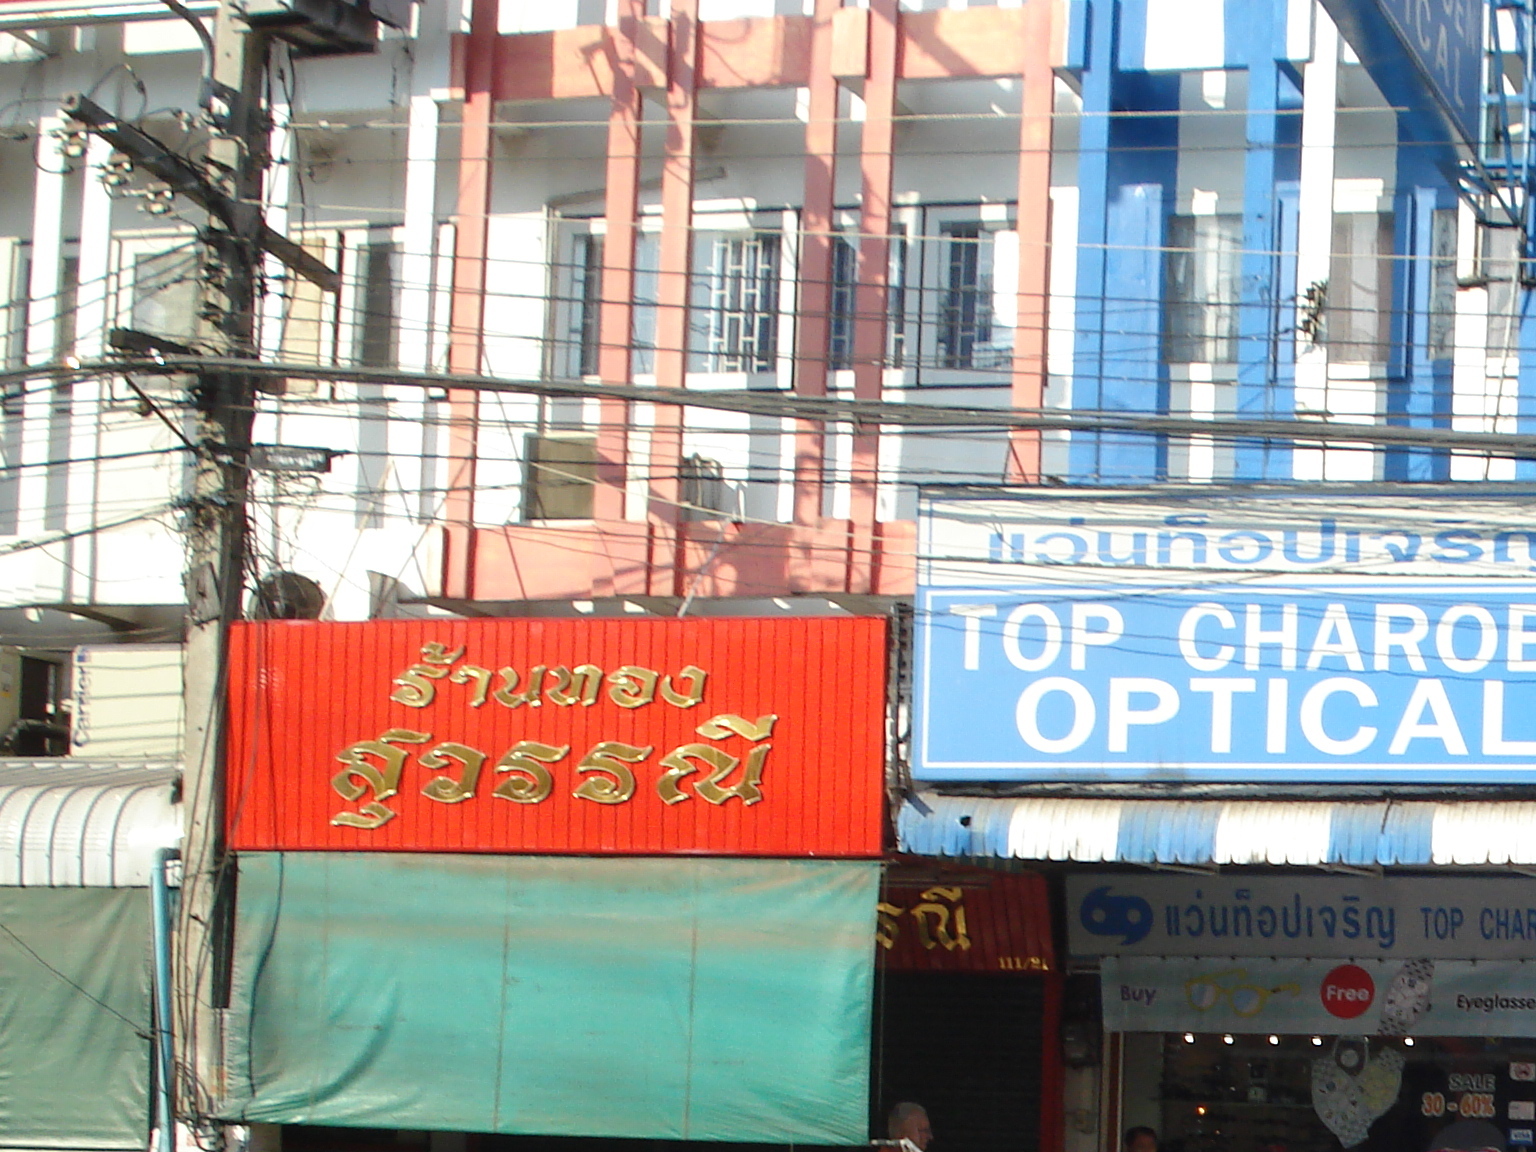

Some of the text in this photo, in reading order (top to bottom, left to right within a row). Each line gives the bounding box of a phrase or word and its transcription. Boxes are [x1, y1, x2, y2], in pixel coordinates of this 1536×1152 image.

[949, 603, 1125, 672] TOP
[388, 640, 709, 710] ร้านทอง
[1165, 888, 1397, 949] แว่นท็อปเจริญ
[1420, 906, 1464, 940] TOP
[1120, 984, 1157, 1006] Buy
[1325, 984, 1370, 1002] Free
[1449, 1073, 1496, 1093] SALE
[1421, 1091, 1446, 1118] 30
[1459, 1092, 1496, 1118] 60%
